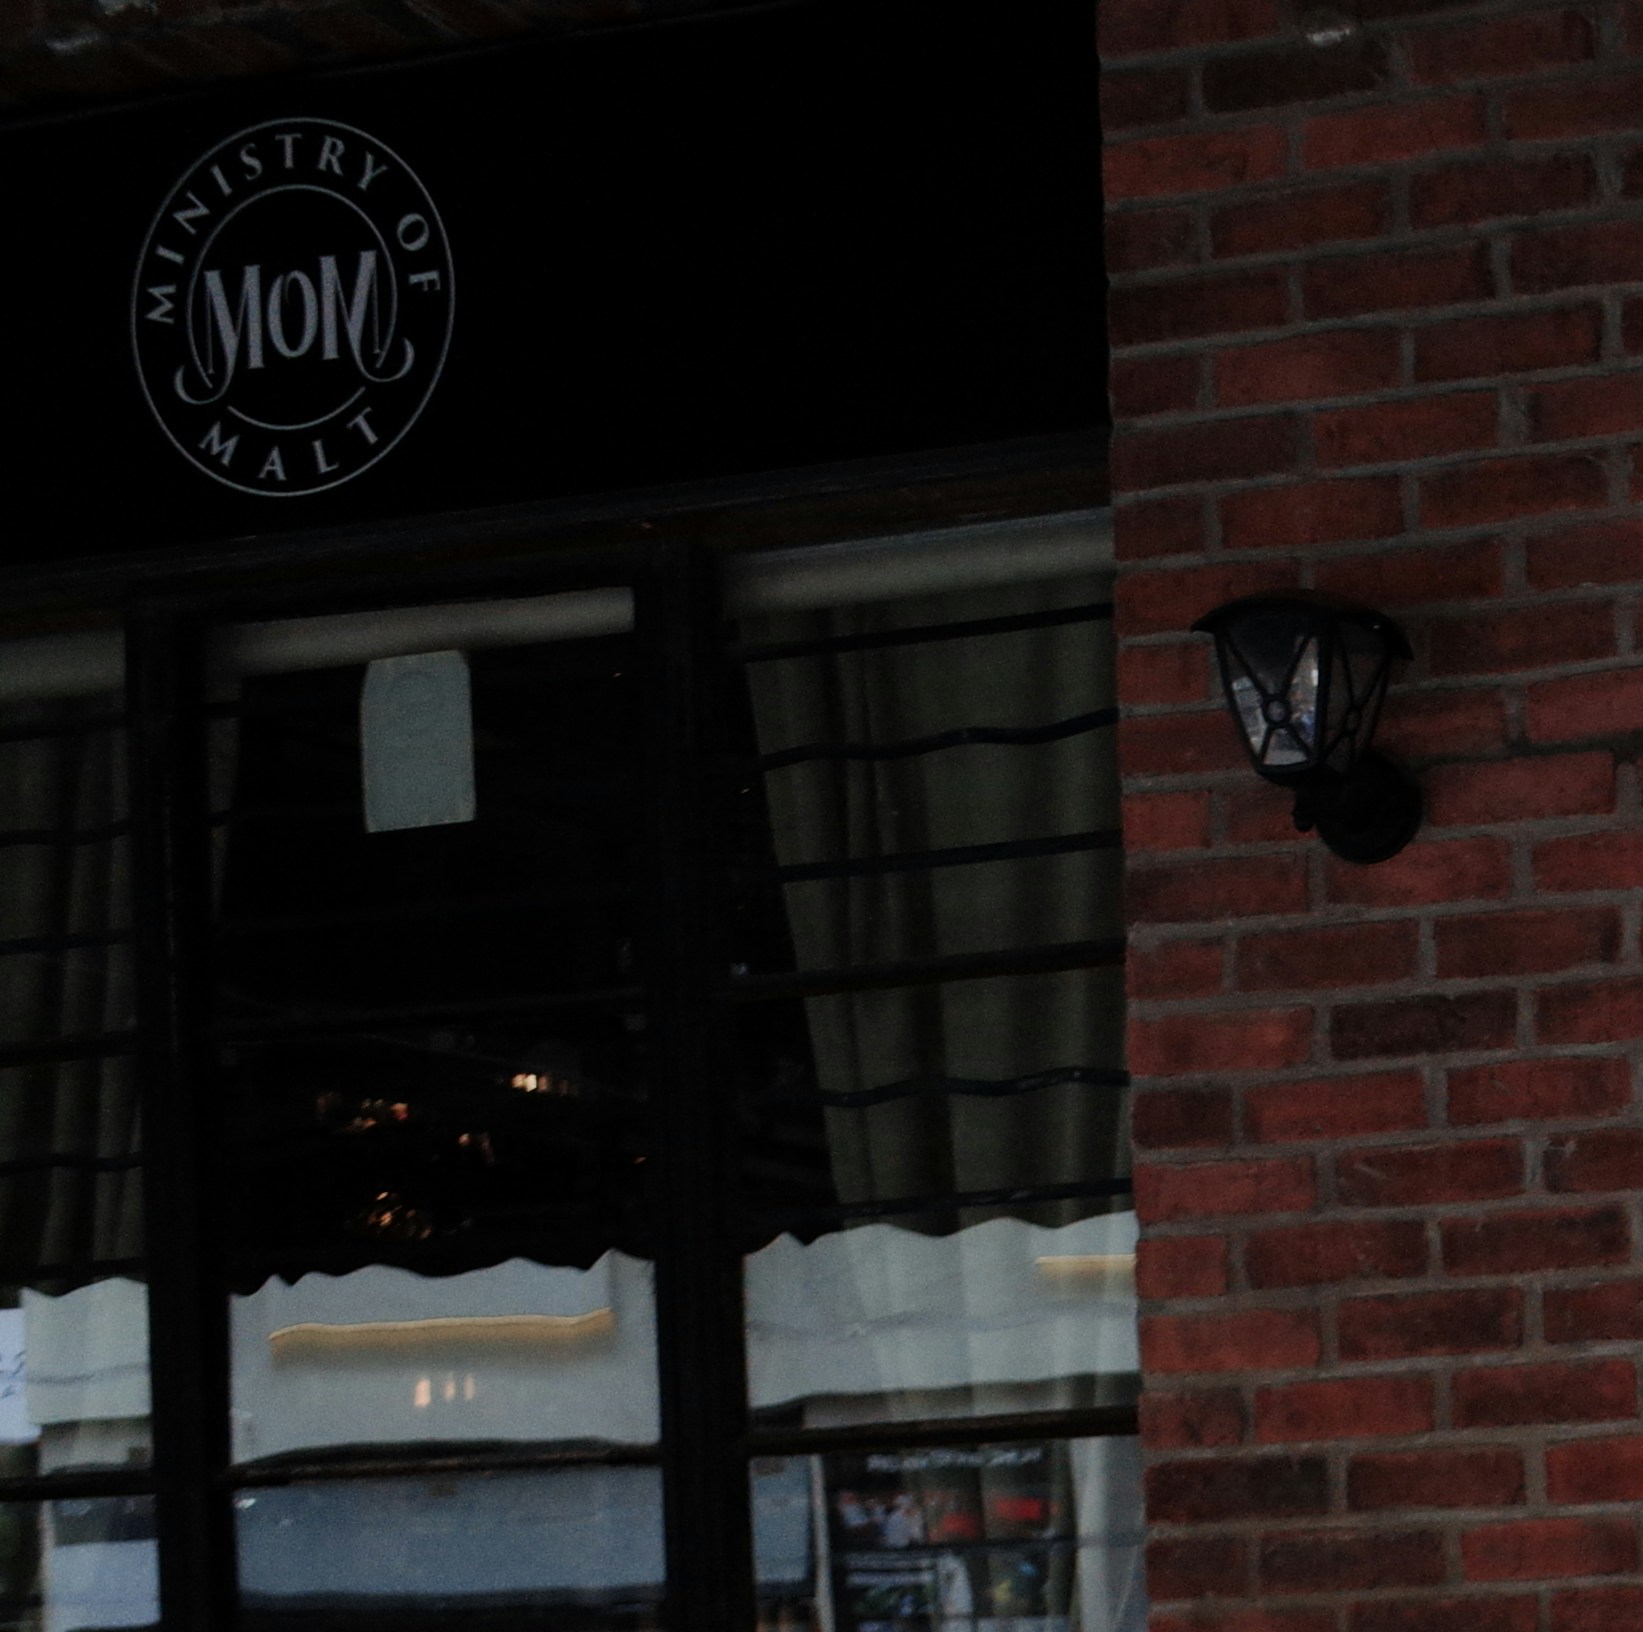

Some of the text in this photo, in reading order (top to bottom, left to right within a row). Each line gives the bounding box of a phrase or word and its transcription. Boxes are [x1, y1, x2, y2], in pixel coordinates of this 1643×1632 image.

[145, 132, 441, 325] MINISTRY OF
[198, 408, 382, 482] MALT
